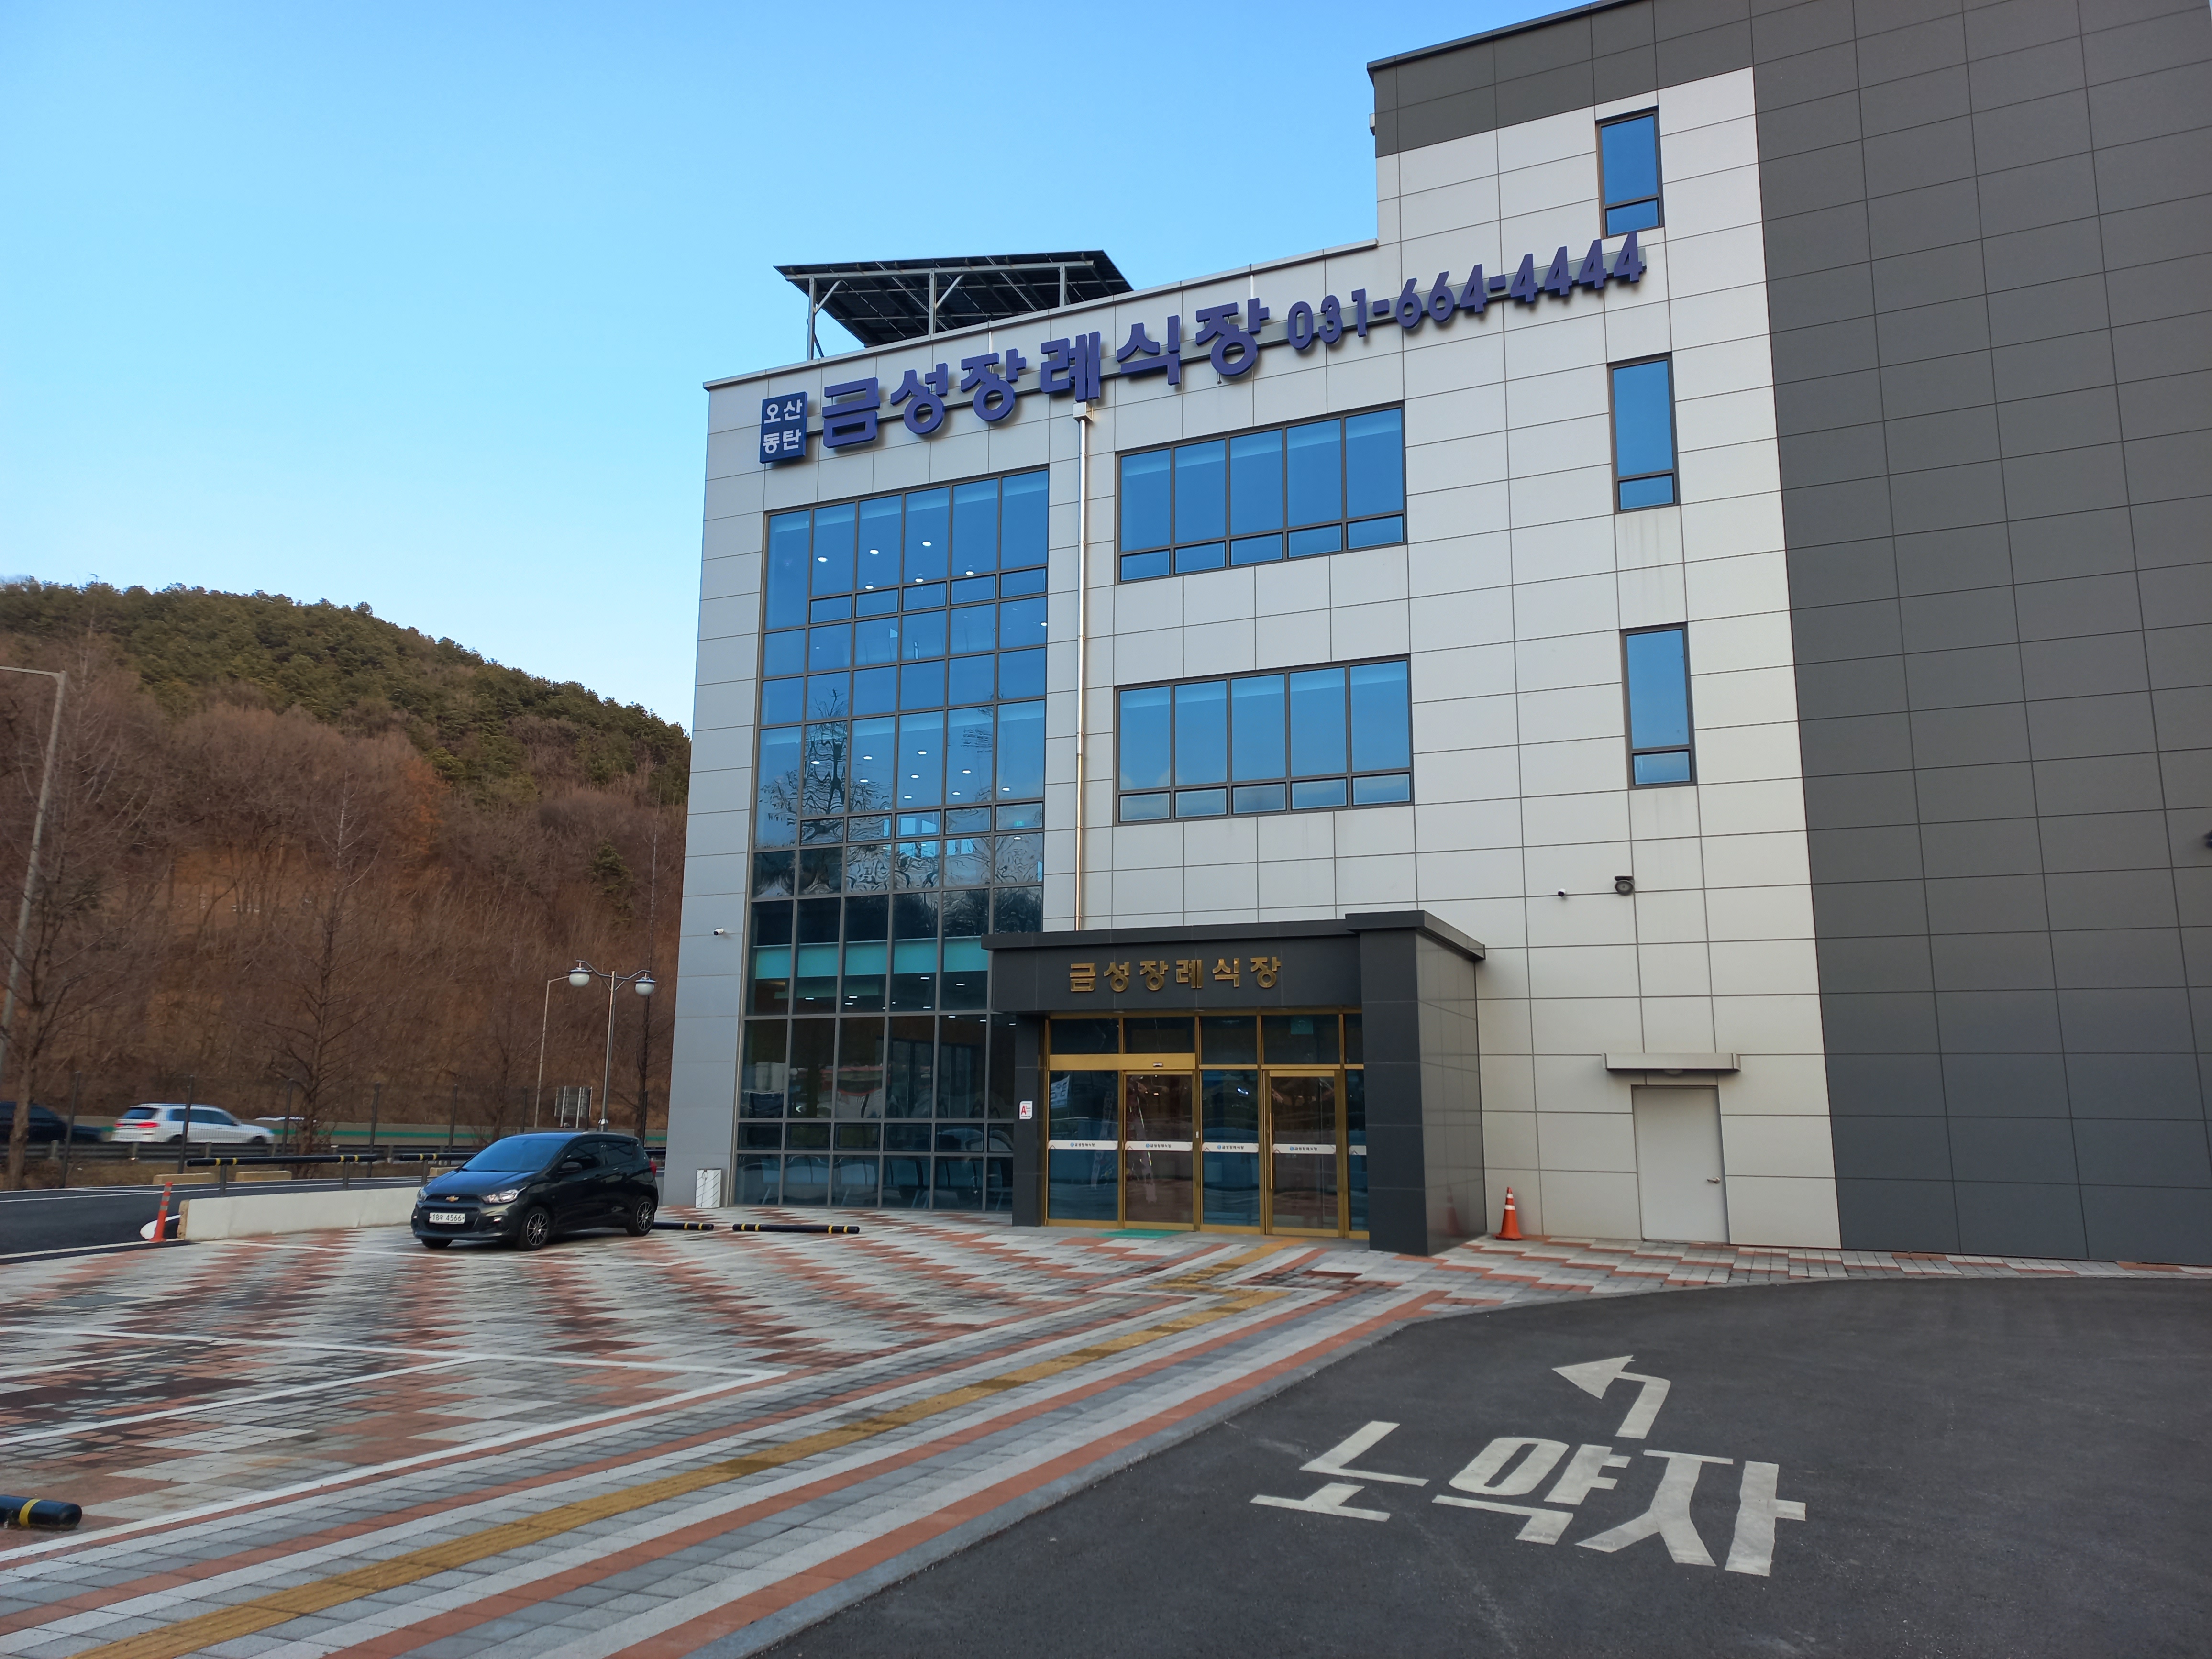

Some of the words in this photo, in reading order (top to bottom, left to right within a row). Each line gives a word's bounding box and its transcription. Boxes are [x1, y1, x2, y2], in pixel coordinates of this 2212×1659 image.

[822, 298, 1270, 449] 금성장례식장
[1288, 231, 1643, 350] 031-664-4444
[763, 398, 803, 424] 오산
[763, 429, 802, 454] 동탄
[1069, 957, 1281, 992] 금성장례식장
[1249, 1420, 1807, 1577] 노약자
